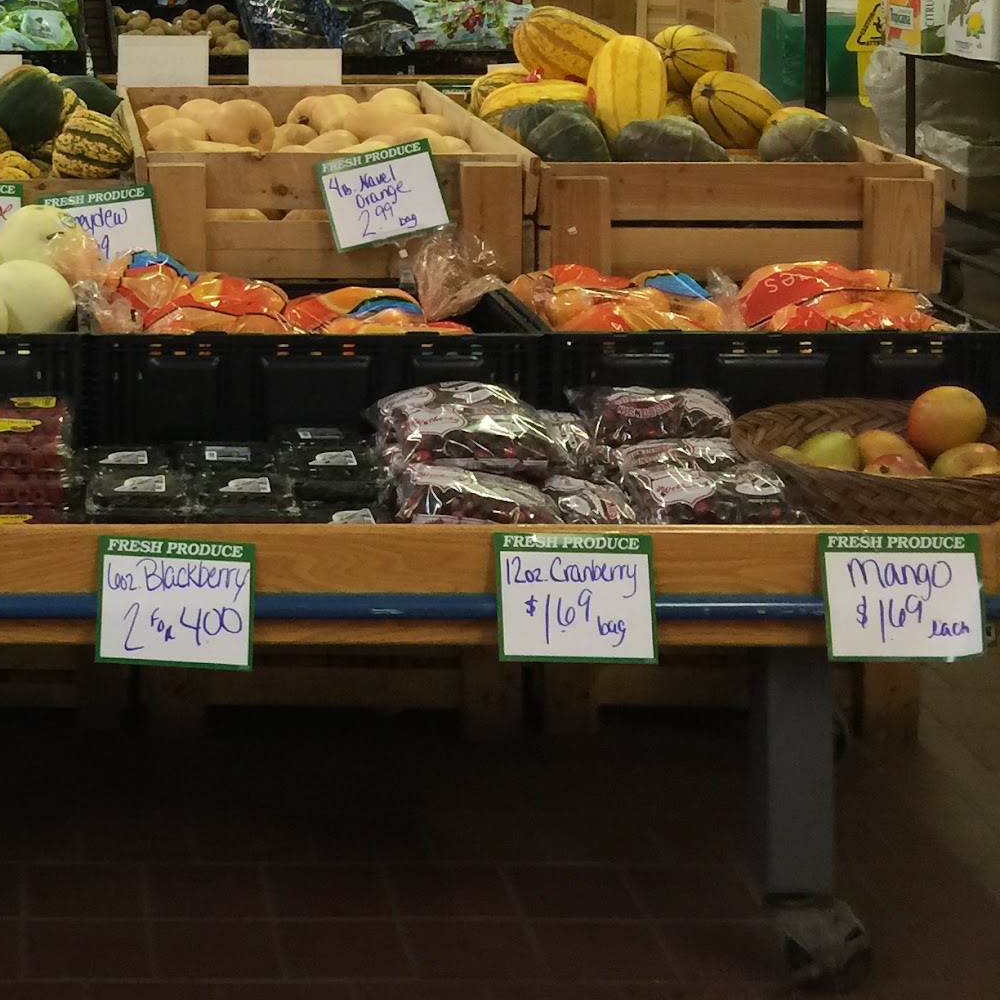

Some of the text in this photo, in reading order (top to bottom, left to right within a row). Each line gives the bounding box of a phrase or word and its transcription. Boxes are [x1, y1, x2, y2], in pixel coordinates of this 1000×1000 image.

[321, 141, 421, 173] FRESH PRODUCE
[360, 164, 396, 192] Navel
[44, 187, 144, 207] FRESH PRODUCE
[355, 180, 412, 209] Orange
[73, 207, 128, 235] eydew
[107, 538, 243, 558] FRESH PRODUCE
[503, 535, 640, 550] FRESH PRODUCE
[827, 535, 965, 549] FRESH PRODUCE
[136, 558, 250, 603] Blackberry
[550, 556, 638, 599] Cranberry
[847, 557, 952, 602] Mango
[123, 602, 144, 651] 2
[597, 615, 626, 648] bag
[928, 619, 970, 639] each
